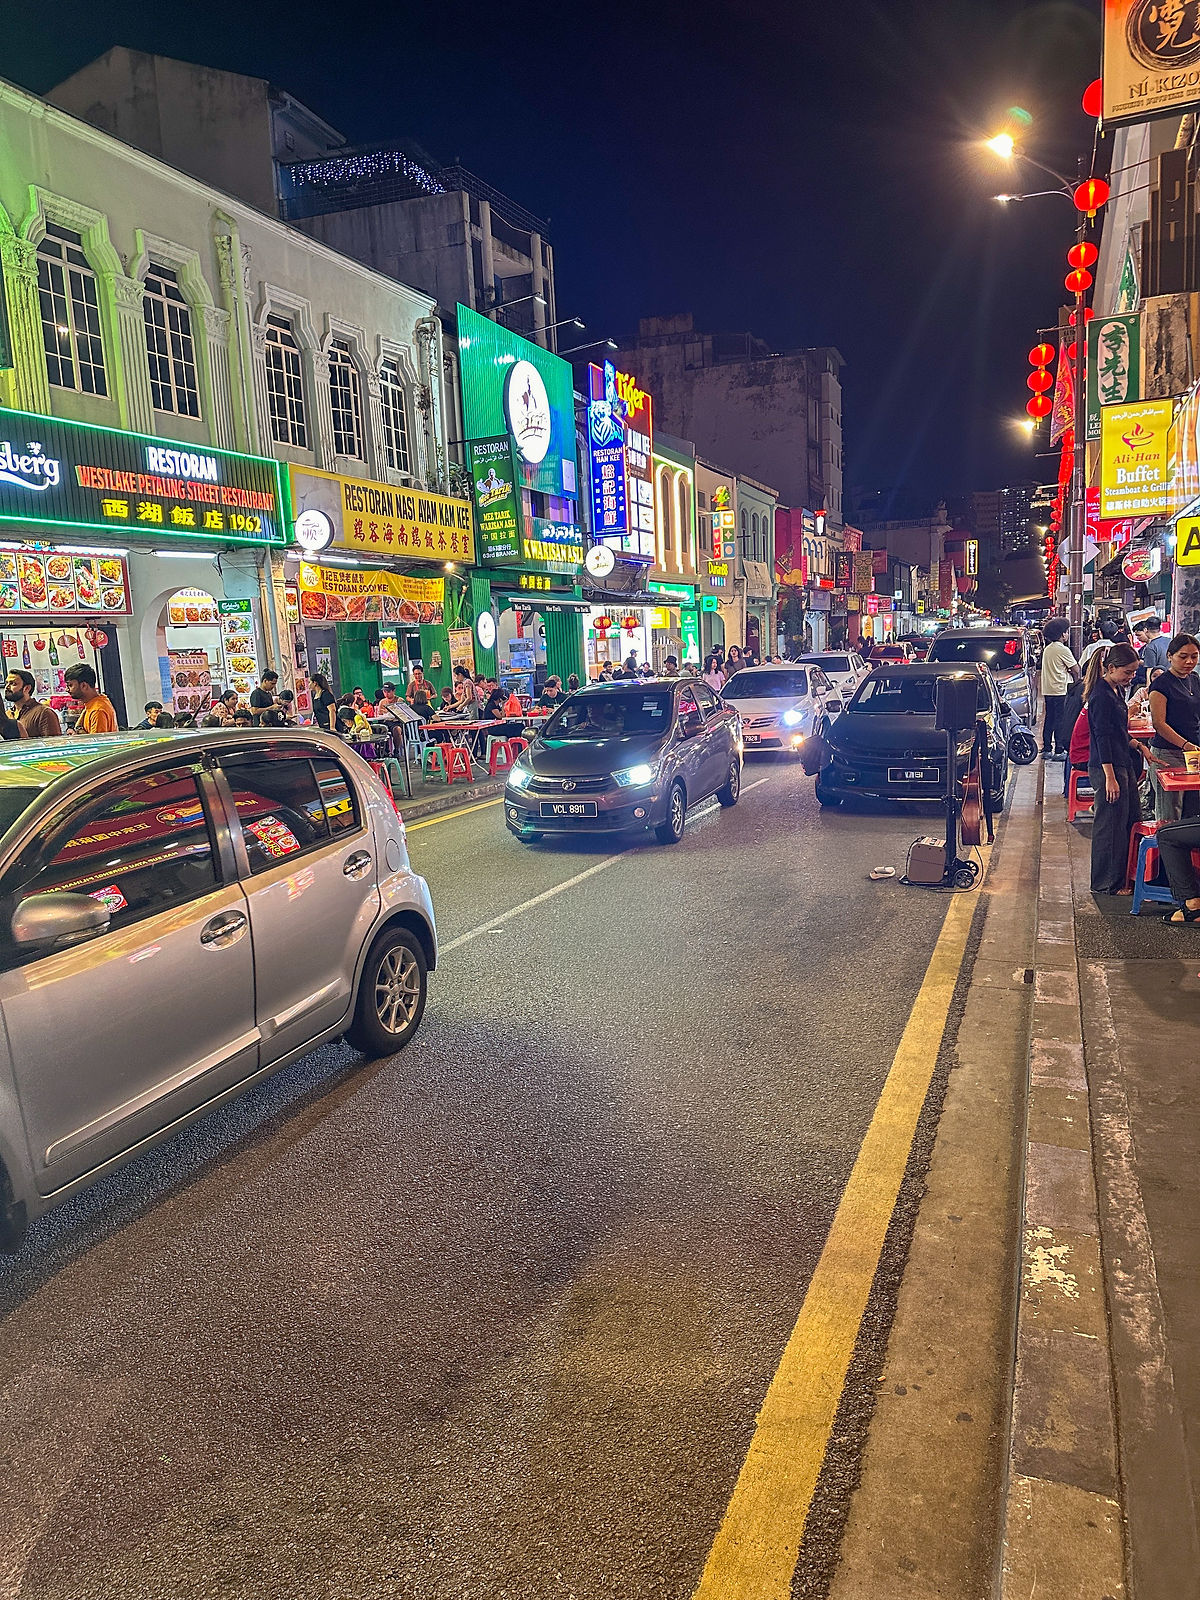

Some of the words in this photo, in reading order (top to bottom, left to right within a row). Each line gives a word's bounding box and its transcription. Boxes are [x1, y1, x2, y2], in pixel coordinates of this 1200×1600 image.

[616, 370, 645, 418] Tiger
[474, 441, 508, 455] RESTORAN
[593, 447, 622, 457] RESTORAN
[146, 446, 217, 481] RESTORAN
[596, 455, 608, 463] HAN
[1116, 465, 1160, 484] Buffet
[75, 464, 137, 493] WESTLAKE
[137, 473, 186, 499] PETALING
[187, 480, 220, 504] STREET
[220, 486, 275, 511] RESTAURANT
[1104, 485, 1140, 496] Steamboat
[1141, 484, 1149, 493] &
[344, 483, 394, 518] RESTORAN
[395, 493, 416, 521] NASI
[418, 498, 438, 525] AYAM
[439, 502, 456, 528] KAM
[456, 506, 470, 530] KEE
[101, 498, 223, 529] 西湖飯店
[229, 514, 262, 533] 1962
[483, 512, 494, 521] MEE
[495, 510, 510, 520] TARIK
[480, 520, 503, 530] WARISAN
[504, 519, 516, 528] ASLI
[482, 529, 515, 541] 中国拉面
[531, 539, 566, 562] WARISAN
[567, 545, 584, 564] ASLI
[552, 804, 568, 814] VCL
